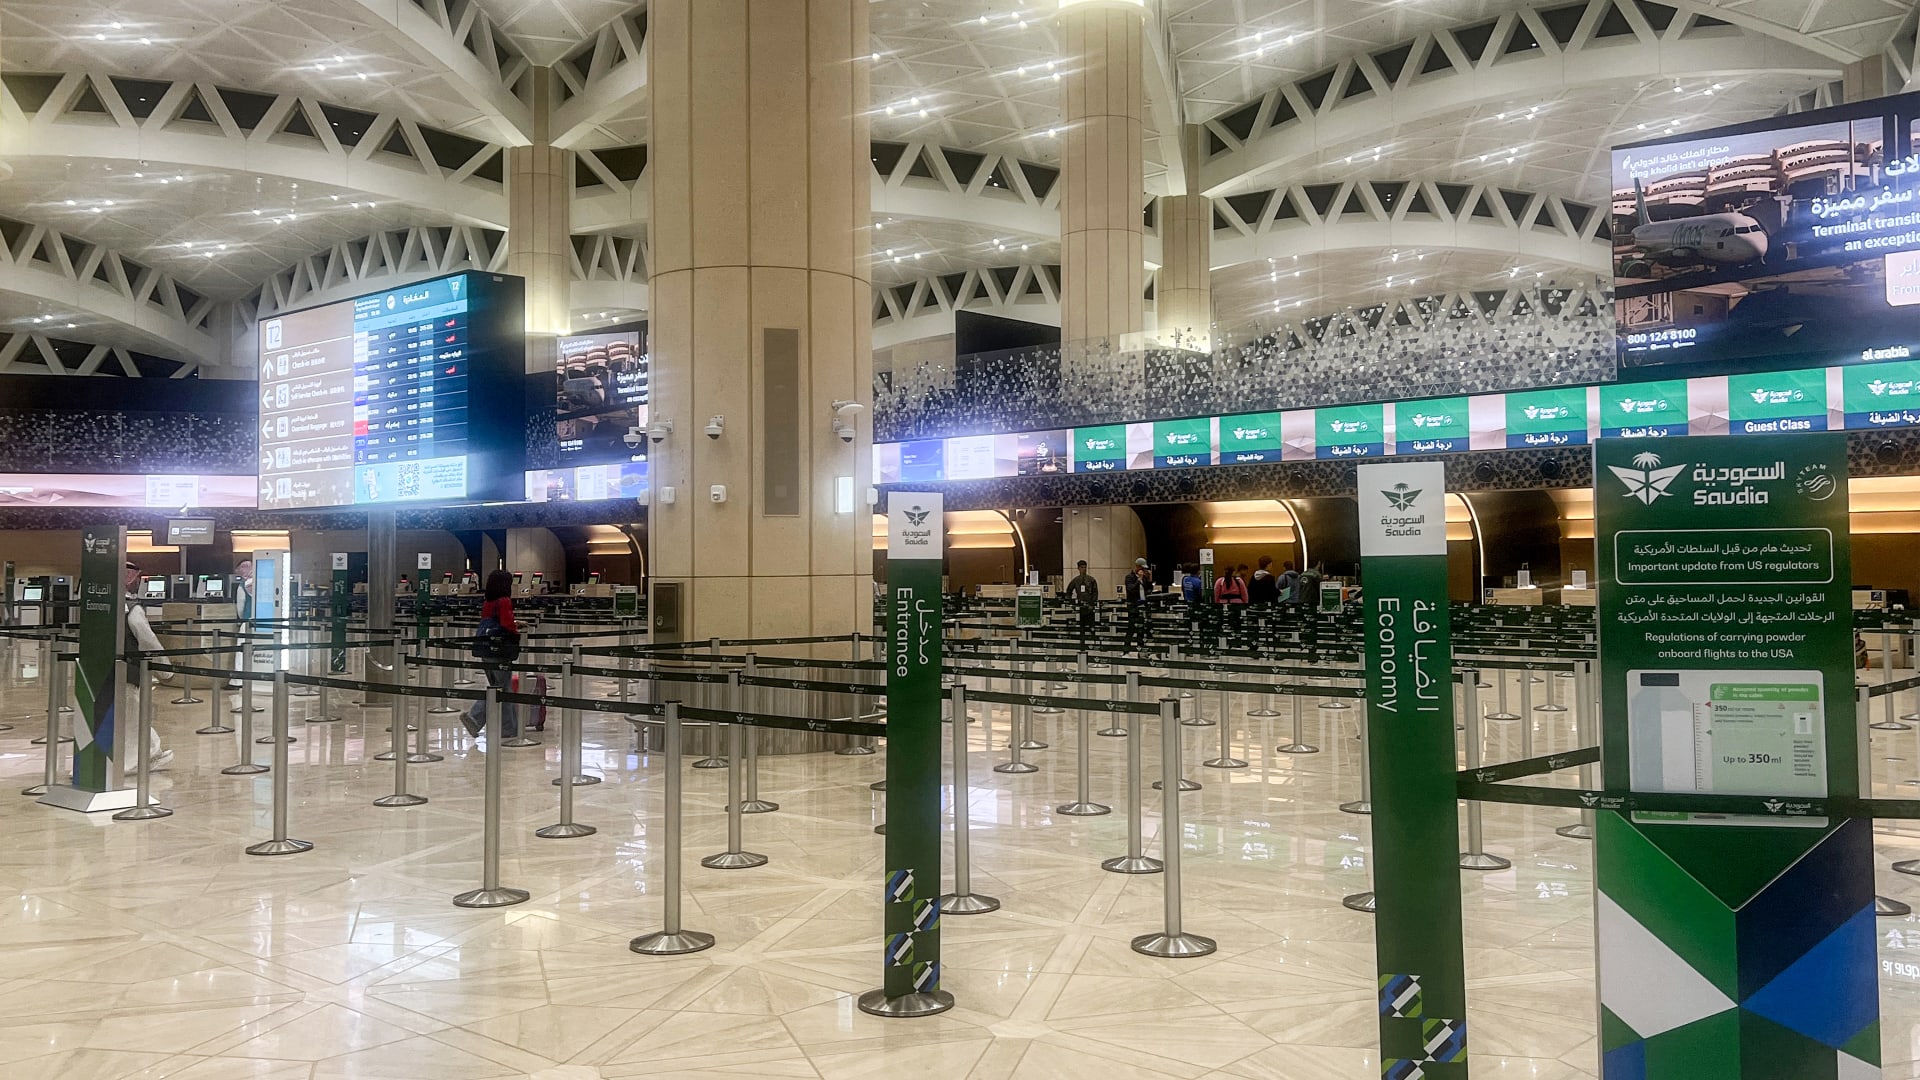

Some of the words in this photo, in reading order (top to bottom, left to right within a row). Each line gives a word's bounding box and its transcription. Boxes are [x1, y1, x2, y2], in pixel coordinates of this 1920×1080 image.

[1680, 149, 1705, 159] الملك
[1707, 146, 1730, 156] مطار
[1630, 157, 1658, 170] الدولي
[1660, 153, 1679, 163] خالد
[1869, 185, 1912, 212] سفر
[1811, 197, 1865, 219] مميزة
[1812, 218, 1872, 237] Terminal
[1844, 240, 1861, 251] an
[267, 325, 281, 343] T2
[1628, 333, 1646, 344] 800
[1649, 332, 1668, 342] 124
[1670, 328, 1697, 340] 8100
[1862, 348, 1873, 360] al
[1873, 345, 1910, 359] arabia
[1902, 409, 1920, 424] رجة
[1744, 421, 1778, 433] Guest
[1779, 419, 1811, 431] Class
[1524, 434, 1548, 445] الضيافة
[1549, 433, 1568, 444] درجة
[1412, 441, 1434, 452] الضيافة
[1435, 440, 1452, 450] درجة
[1693, 461, 1785, 487] السعودية
[1693, 486, 1769, 505] Saudia
[1381, 514, 1425, 528] السعودية
[902, 529, 931, 538] السعودية
[1385, 527, 1421, 537] Saudia
[1633, 541, 1675, 556] الأمريكية
[1676, 544, 1719, 554] السلطات
[1721, 543, 1740, 555] قبل
[1742, 546, 1758, 555] من
[1760, 544, 1778, 556] هام
[1779, 543, 1812, 555] تحديث
[1628, 562, 1679, 573] Important
[1681, 561, 1718, 573] update
[1720, 560, 1745, 570] from
[1747, 560, 1763, 570] US
[1765, 560, 1820, 572] regulators
[1625, 595, 1646, 606] متن
[1647, 594, 1665, 606] على
[1666, 593, 1715, 605] المساحيق
[1717, 593, 1746, 605] لحمل
[1748, 593, 1783, 605] الجديدة
[1785, 593, 1825, 605] القوانين
[1617, 609, 1658, 624] الأمريكية
[1660, 612, 1699, 622] المتحدة
[1701, 611, 1736, 624] الولايات
[1738, 612, 1754, 624] إلى
[1755, 611, 1796, 624] المتجهة
[1797, 611, 1835, 623] الرحلات
[896, 587, 913, 677] Entrance
[915, 599, 935, 665] مدخل
[1645, 632, 1705, 643] Regulations
[1707, 632, 1718, 642] of
[1720, 632, 1764, 644] carrying
[1765, 632, 1806, 643] powder
[1376, 597, 1400, 713] Economy
[1408, 599, 1440, 711] الضيافة
[1658, 649, 1701, 658] onboard
[1703, 649, 1736, 660] flights
[1738, 650, 1749, 658] to
[1751, 649, 1768, 658] the
[1770, 649, 1794, 658] USA
[1723, 755, 1735, 764] Up
[1748, 753, 1770, 764] 350
